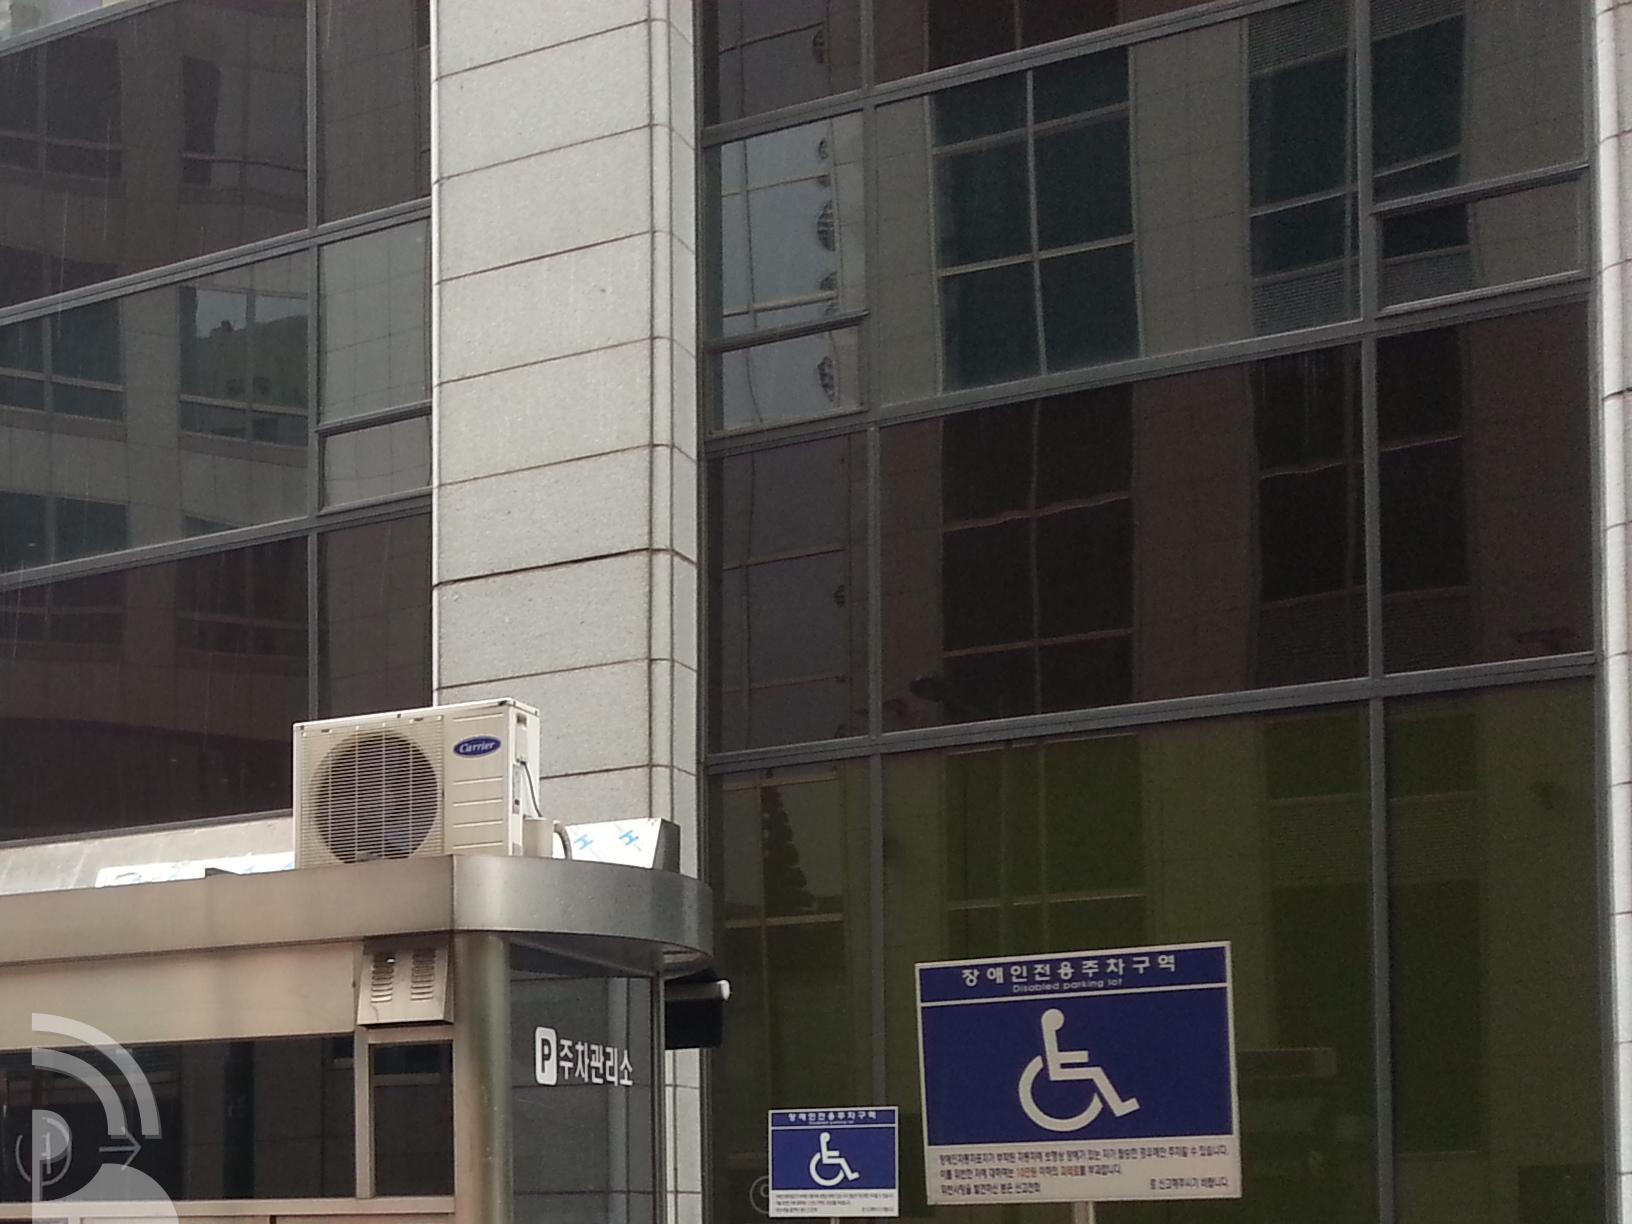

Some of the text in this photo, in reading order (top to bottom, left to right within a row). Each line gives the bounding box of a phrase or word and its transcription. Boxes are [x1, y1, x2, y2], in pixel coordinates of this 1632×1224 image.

[459, 740, 496, 753] Carrier
[961, 954, 1176, 987] 장애인전용주차구역
[1013, 977, 1123, 993] Disabled parking lot
[559, 1038, 633, 1087] 주차관리소
